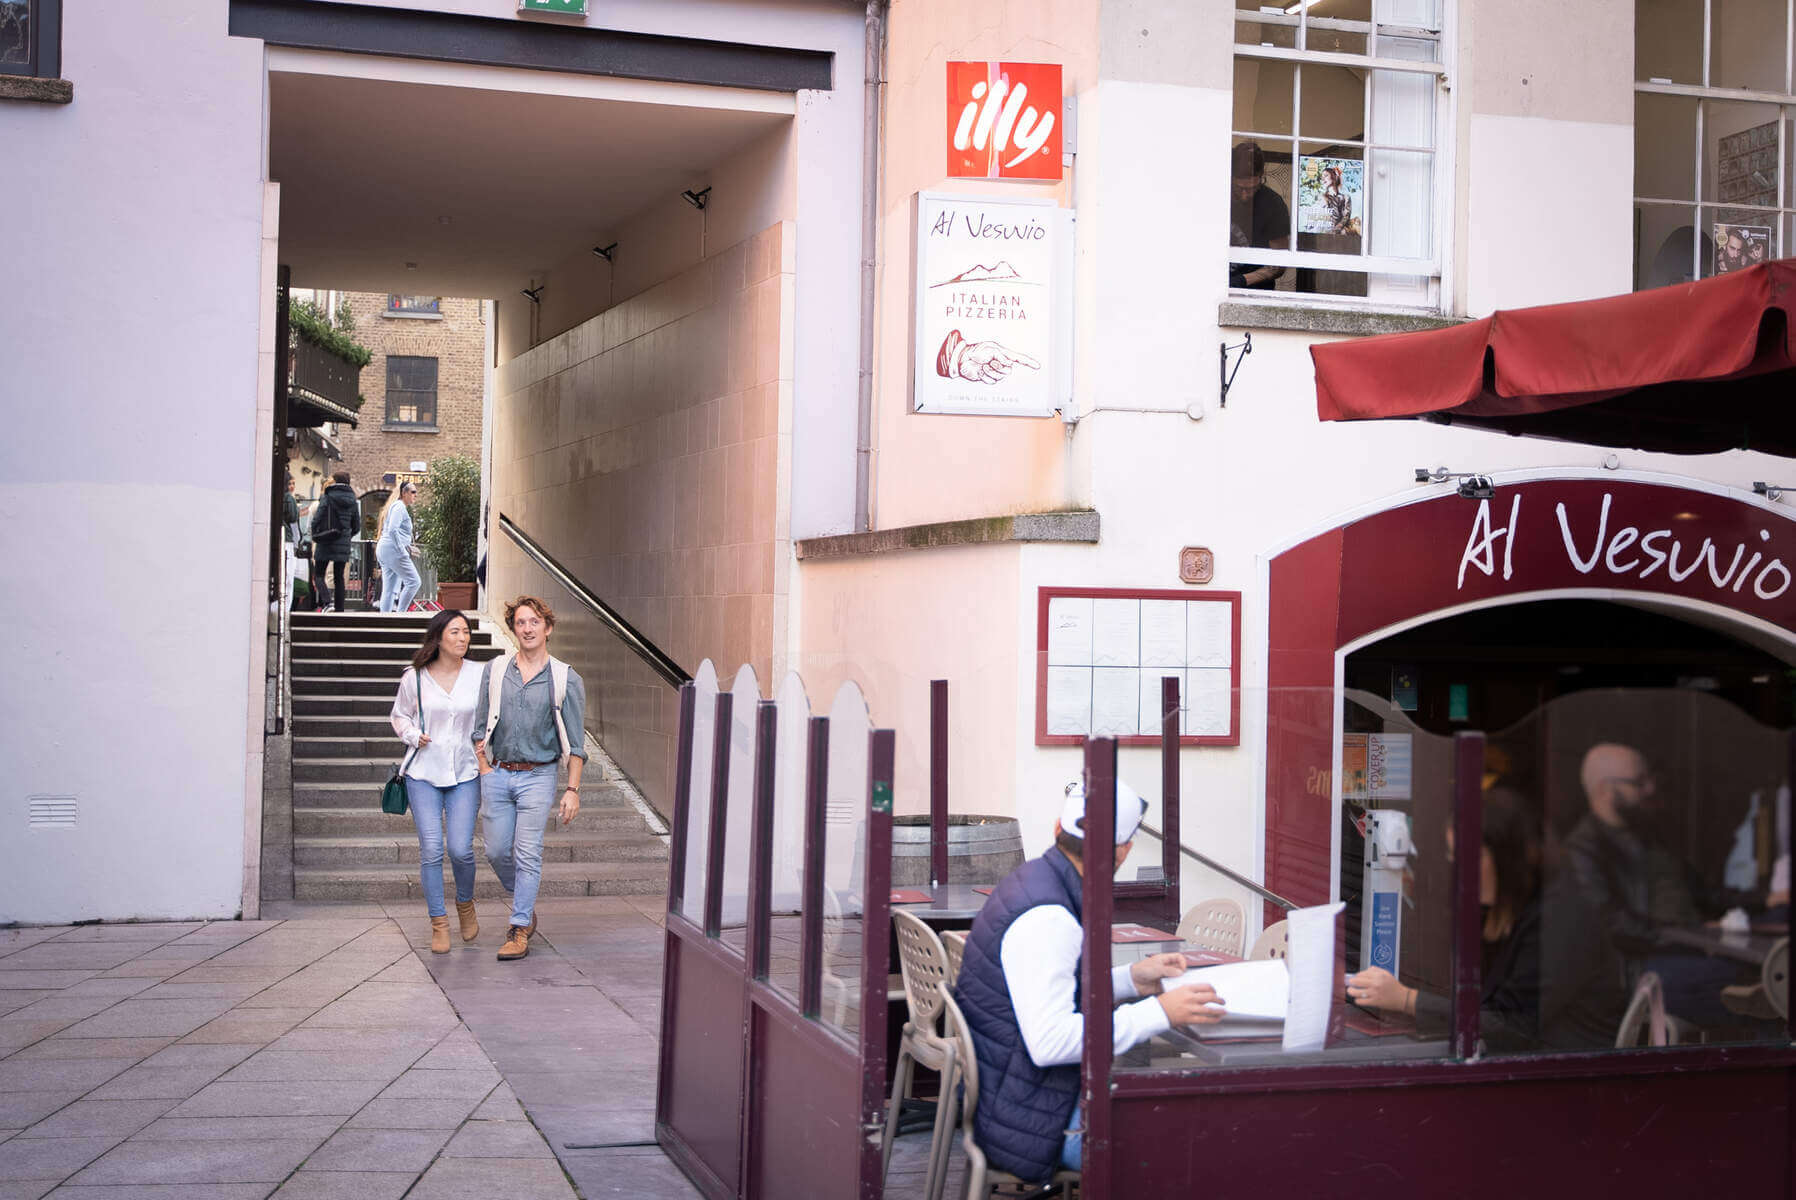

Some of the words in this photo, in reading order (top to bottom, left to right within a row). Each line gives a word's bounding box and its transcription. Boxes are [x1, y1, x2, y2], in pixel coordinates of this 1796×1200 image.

[954, 80, 1055, 168] illy
[930, 209, 956, 238] Al
[965, 212, 1046, 242] Vesuvio
[945, 306, 1027, 320] PIZZERIA
[952, 292, 1022, 307] ITALIAN
[1457, 493, 1522, 590] Al
[1555, 492, 1791, 600] Vesuvio
[1370, 754, 1380, 790] COVER
